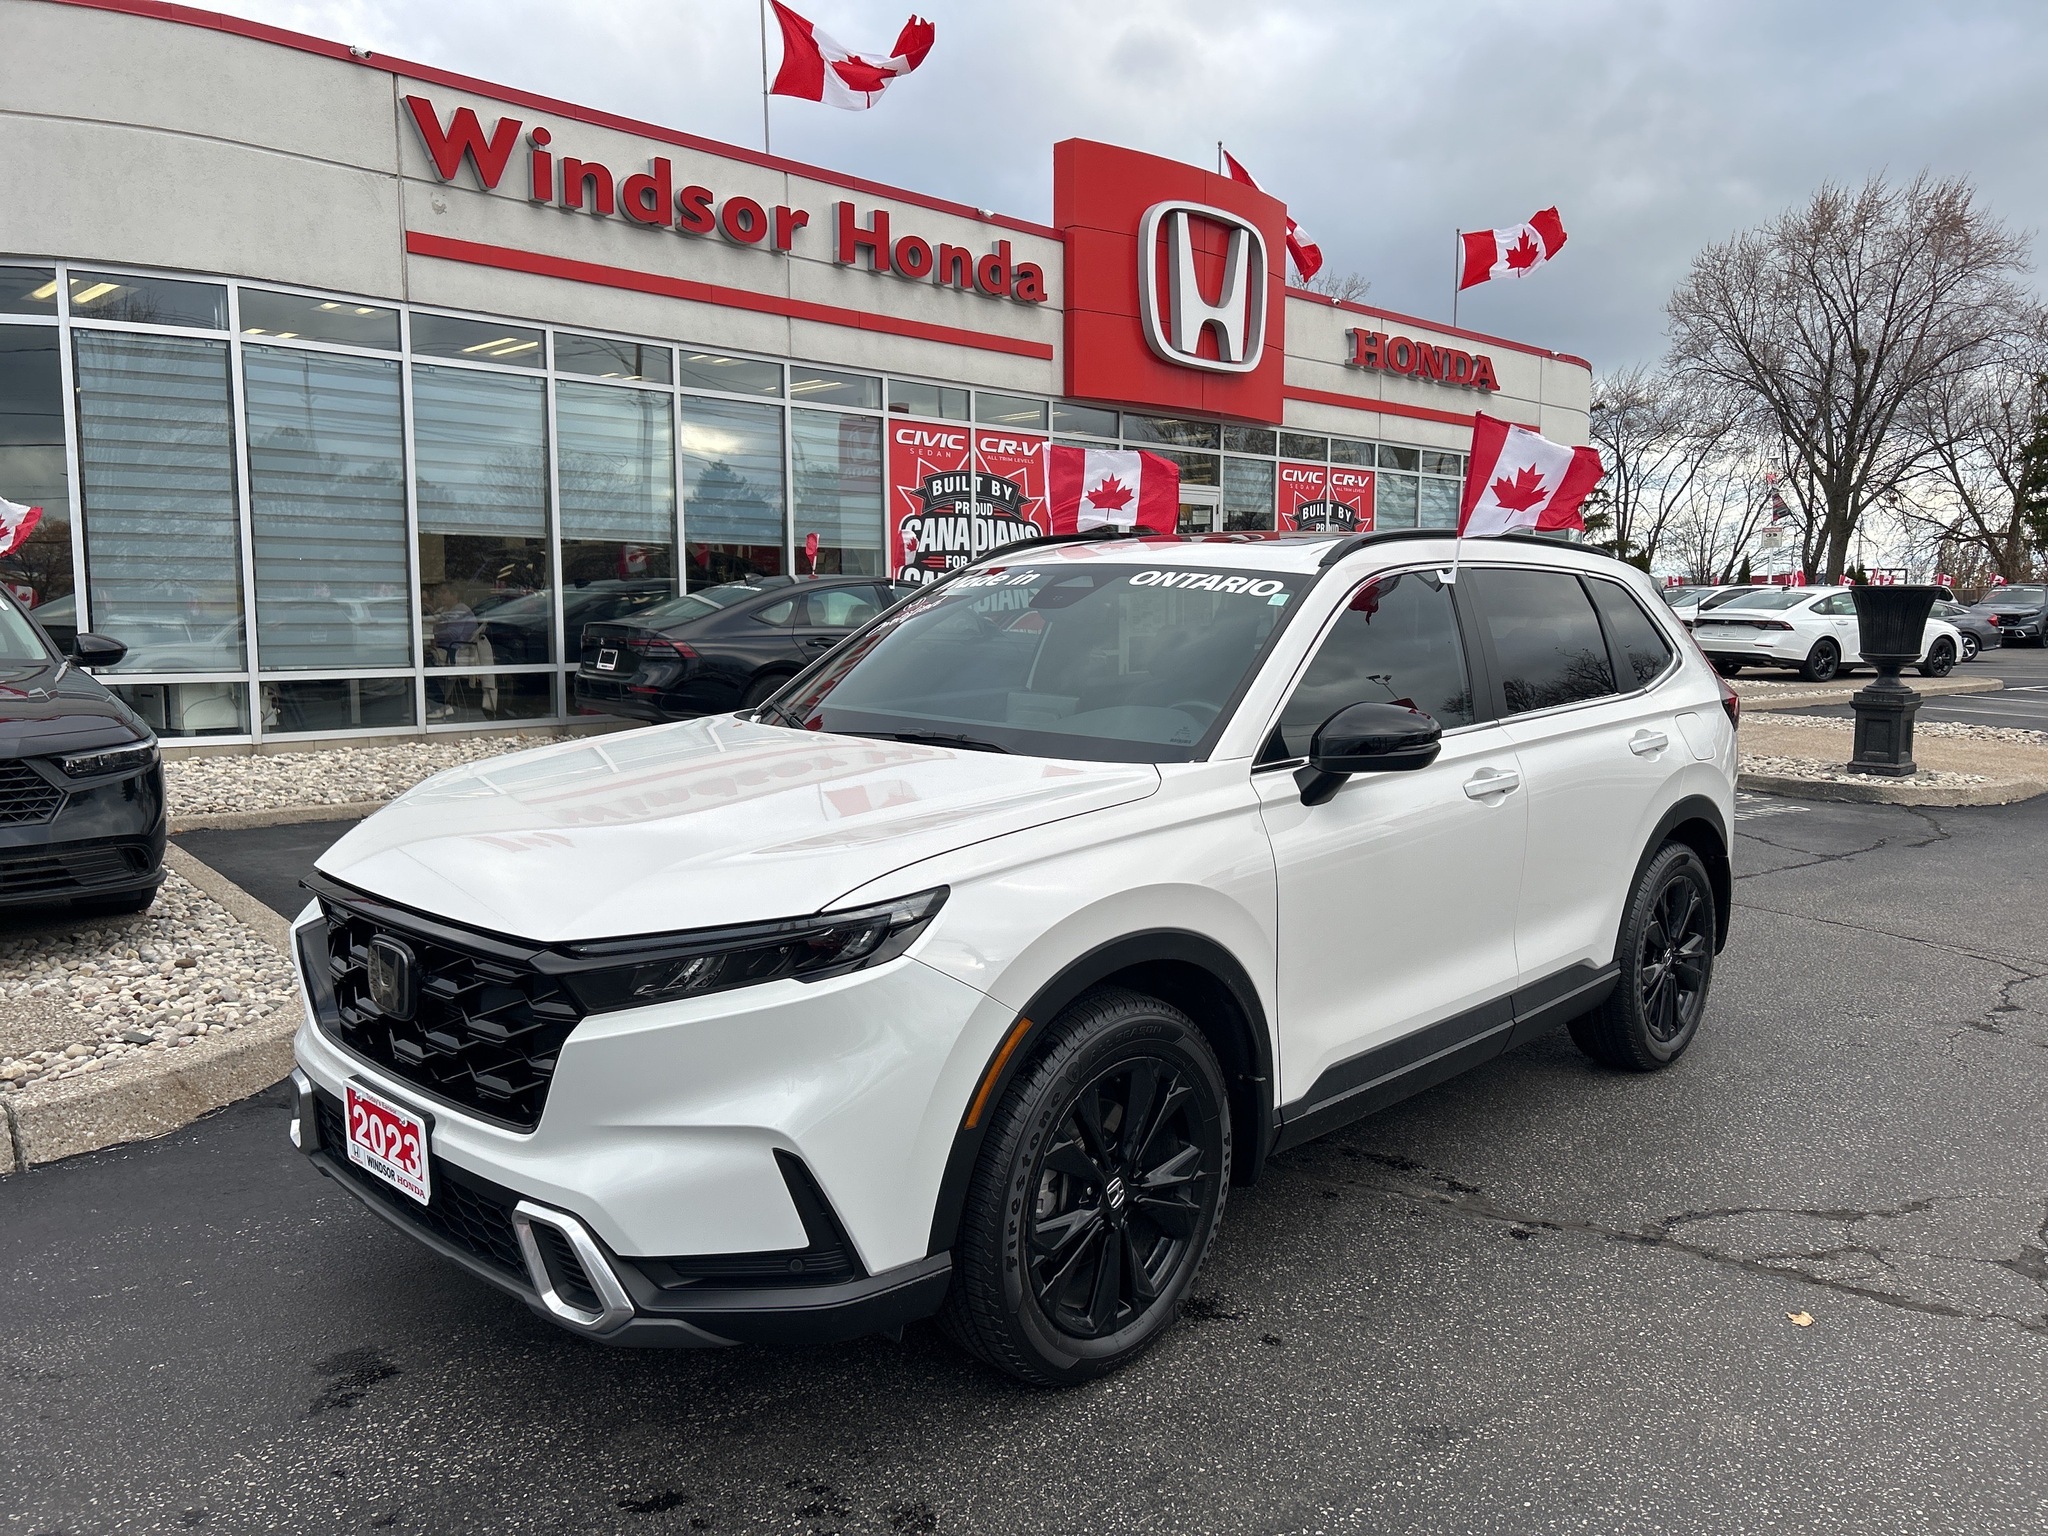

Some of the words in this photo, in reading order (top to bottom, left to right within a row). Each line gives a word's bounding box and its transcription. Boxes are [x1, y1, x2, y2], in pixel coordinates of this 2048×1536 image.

[401, 95, 809, 252] Windsor
[833, 201, 1048, 302] Honda
[1346, 328, 1500, 392] HONDA
[896, 428, 966, 450] CIVIC
[980, 437, 1041, 457] CR-V
[909, 447, 952, 459] SEDAN
[1013, 457, 1034, 465] LEVELS
[1282, 469, 1324, 484] CIVIC
[1332, 473, 1370, 487] CR-V
[932, 475, 983, 497] BUILT
[991, 480, 1013, 501] BY
[955, 501, 993, 516] PROUD
[1302, 503, 1334, 520] BUILT
[1338, 506, 1352, 522] BY
[945, 555, 969, 568] FOR
[1009, 569, 1041, 586] in
[1128, 569, 1285, 598] ONTARIO
[353, 1104, 421, 1178] 2023
[367, 1155, 396, 1182] WINDSOR
[396, 1174, 426, 1200] HONDA
